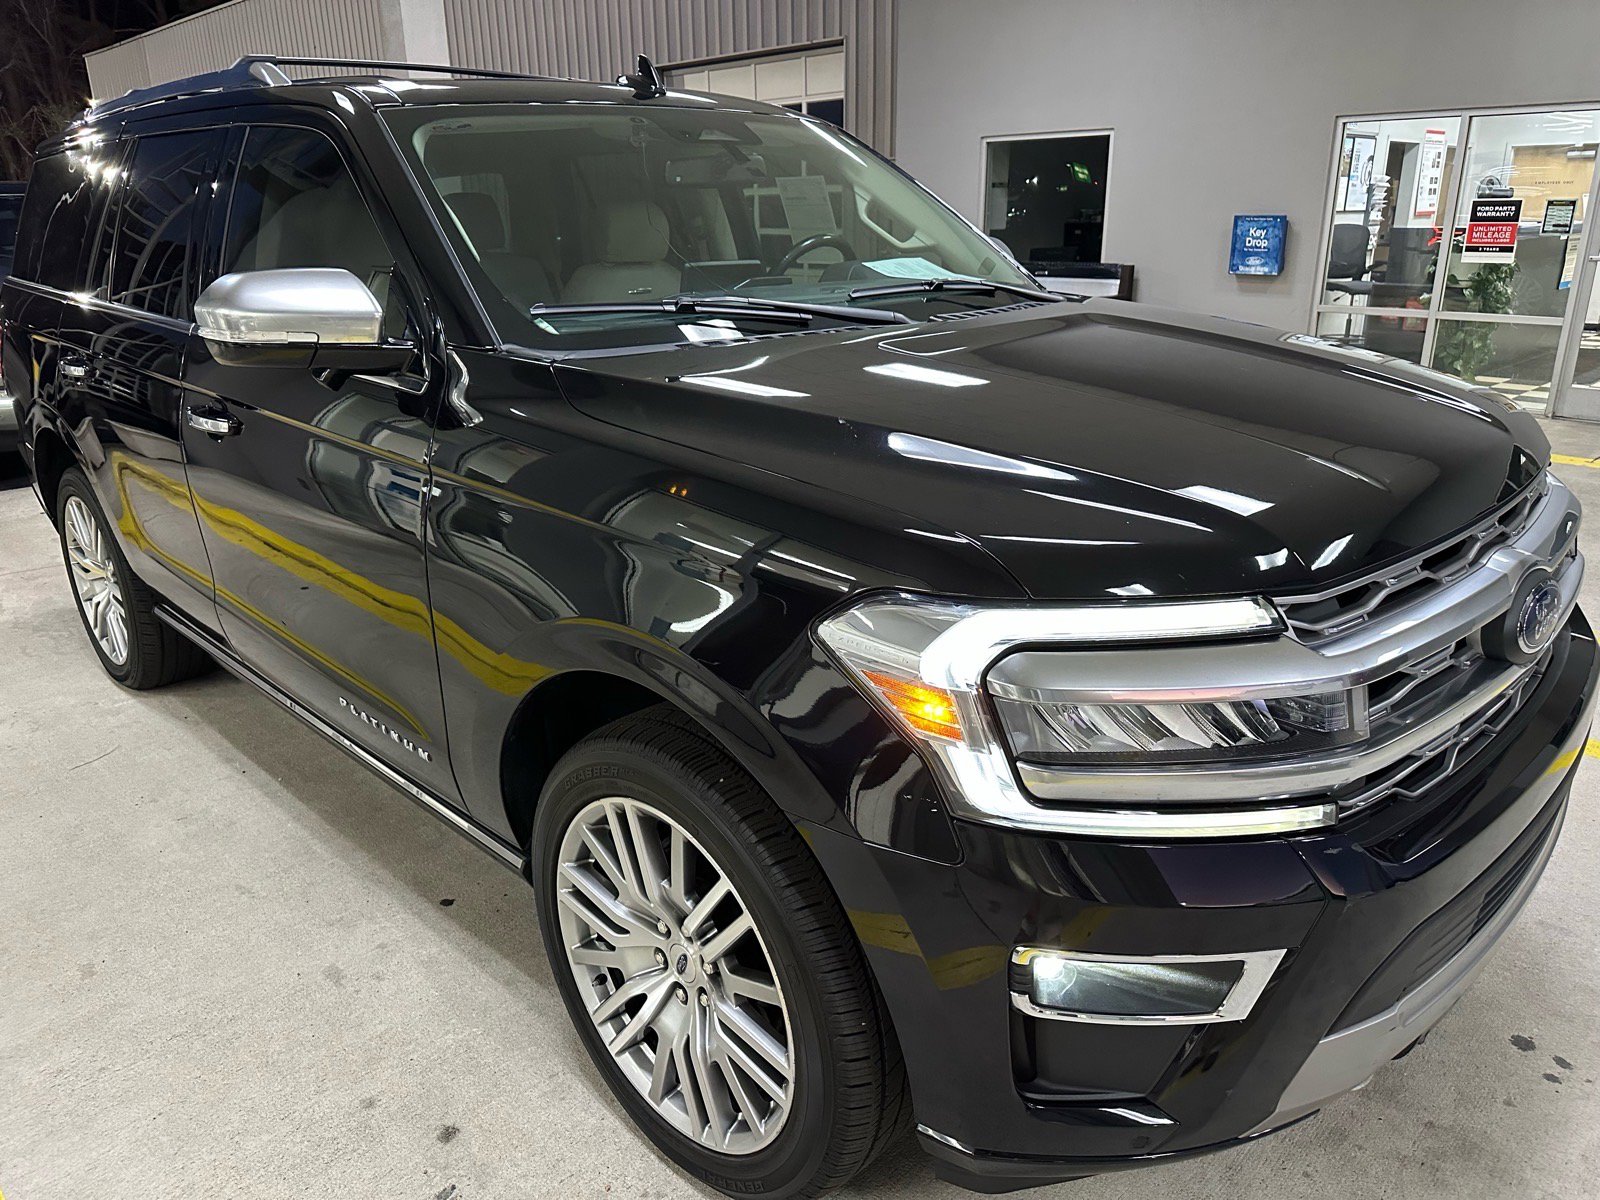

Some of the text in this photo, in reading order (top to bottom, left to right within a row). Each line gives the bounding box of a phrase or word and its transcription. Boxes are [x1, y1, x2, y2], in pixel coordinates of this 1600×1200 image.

[1249, 226, 1267, 239] Key
[1472, 231, 1512, 239] MILEAGE
[1245, 237, 1268, 249] Drop
[339, 696, 432, 762] PLATINUM
[562, 765, 620, 791] GRABBER
